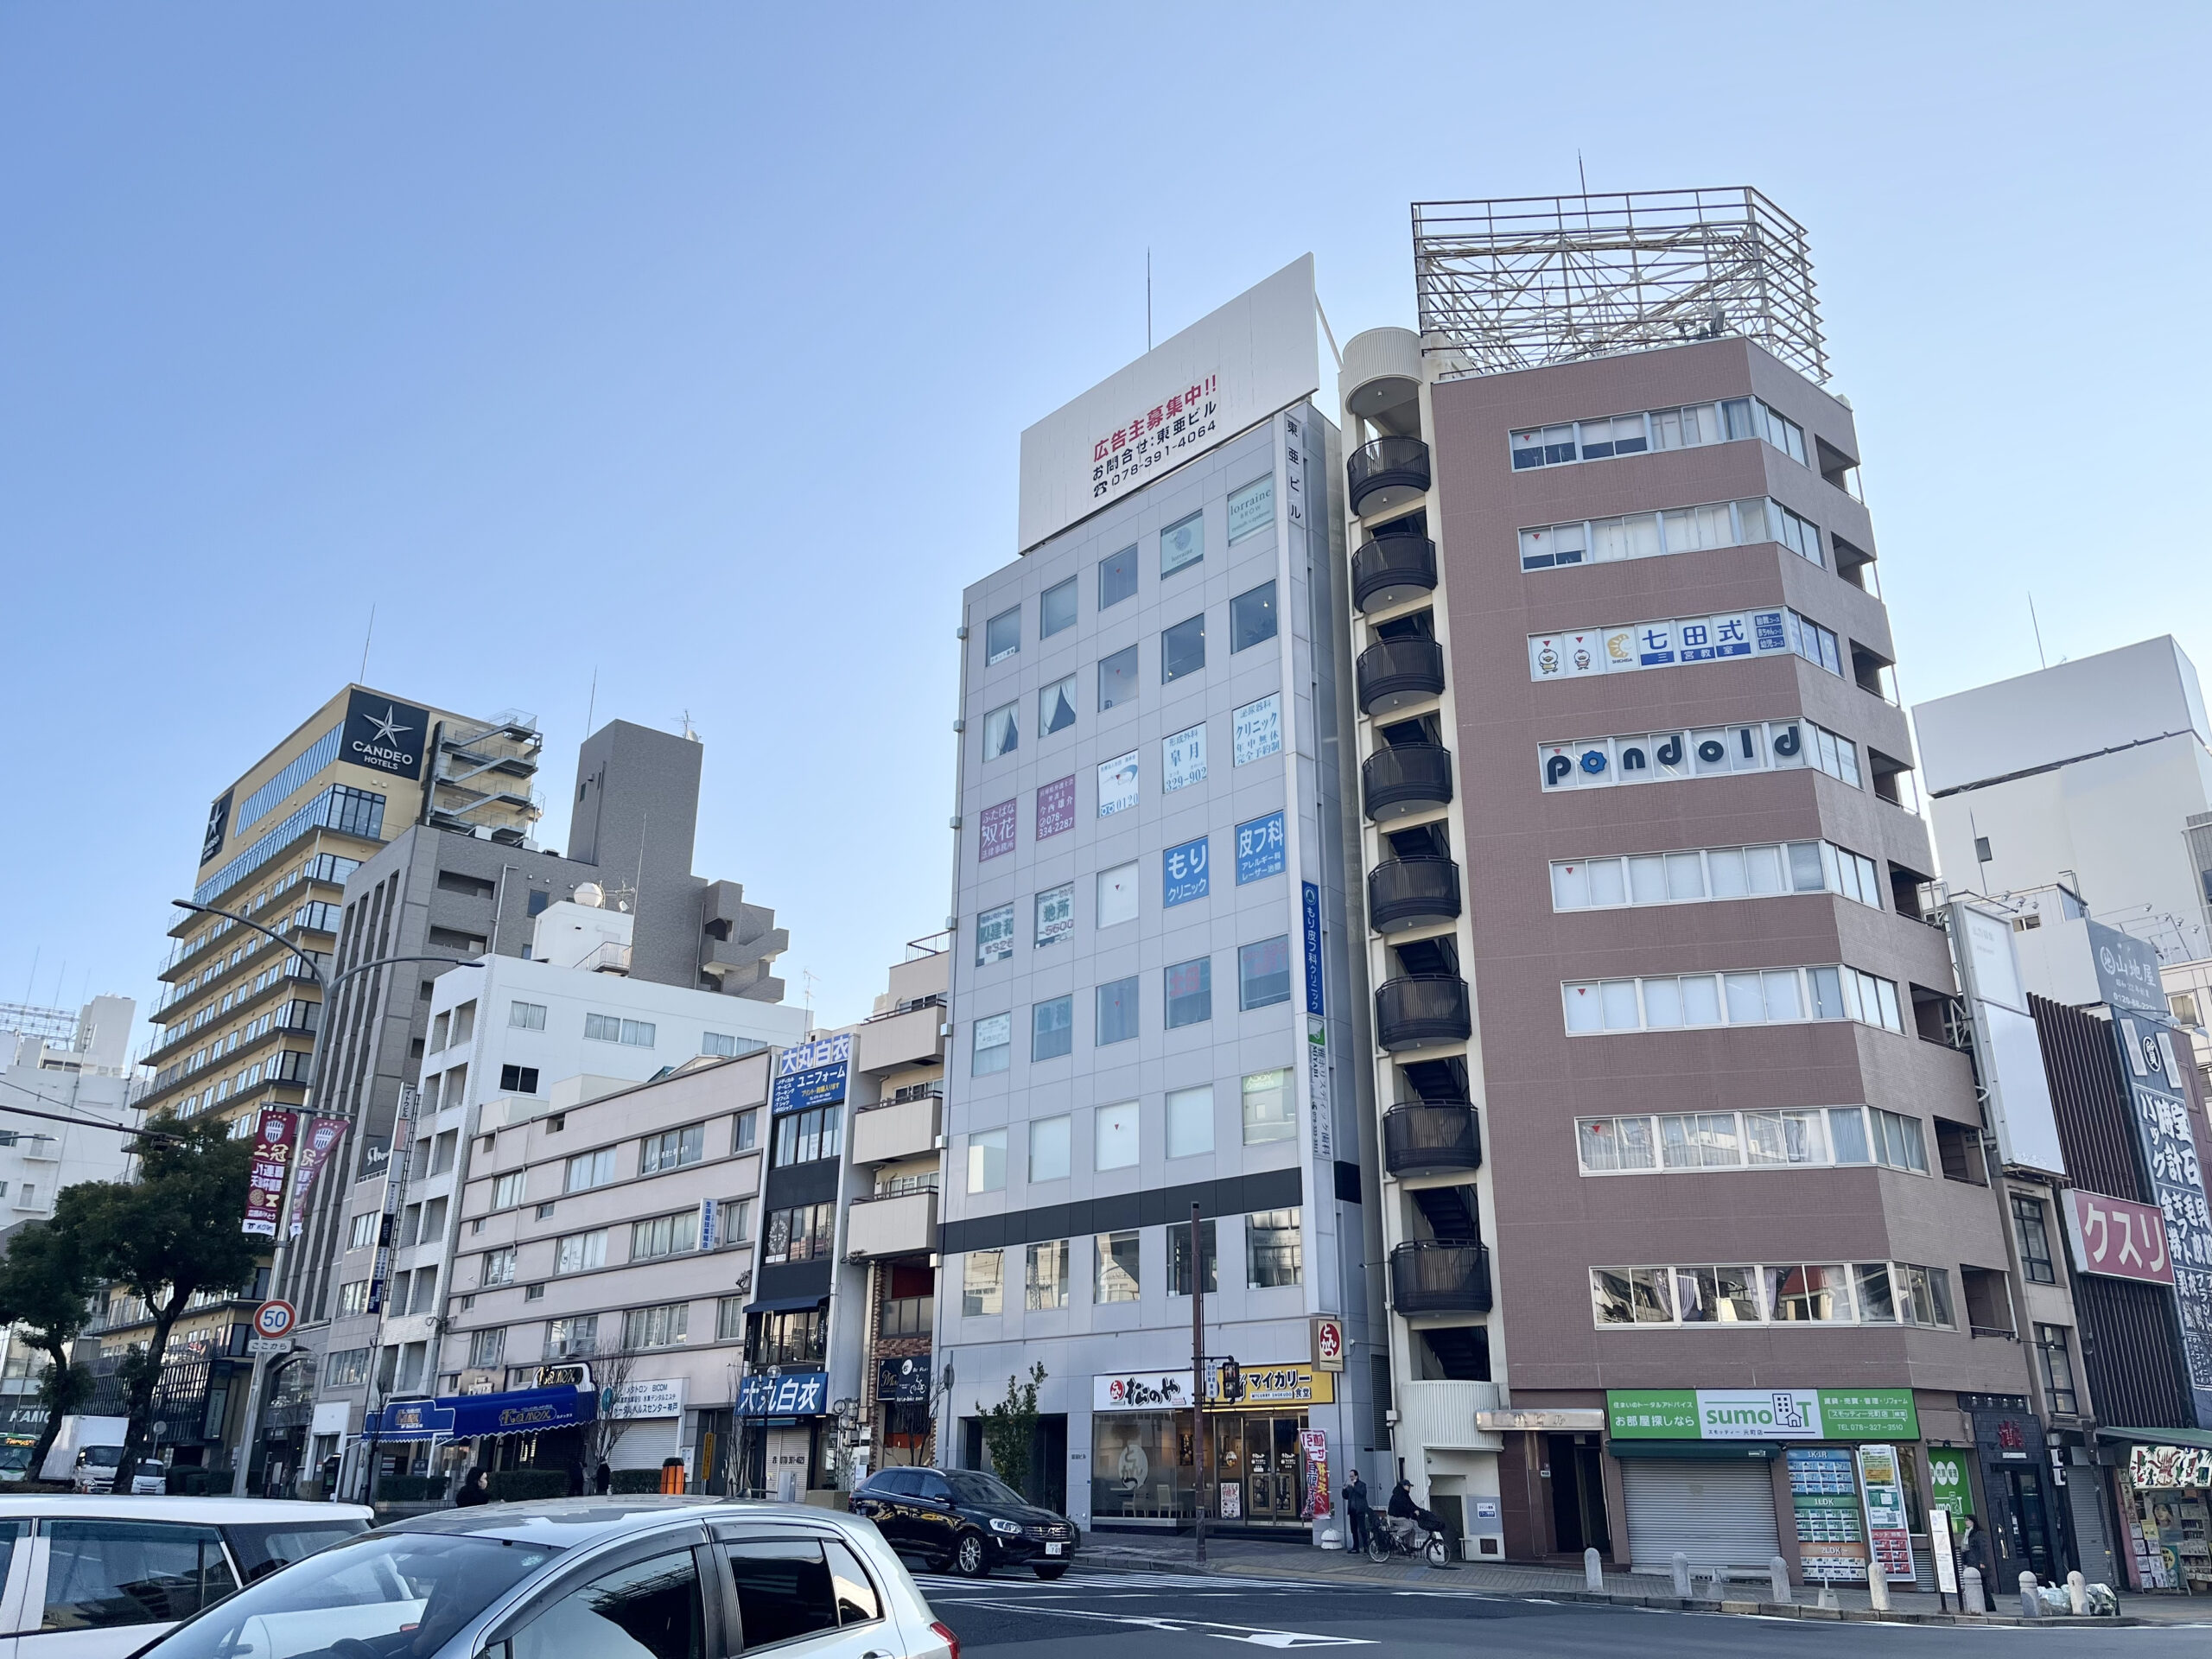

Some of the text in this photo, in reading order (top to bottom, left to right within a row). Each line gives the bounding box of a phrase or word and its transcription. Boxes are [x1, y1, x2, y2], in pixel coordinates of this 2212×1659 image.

[1093, 374, 1217, 462] 広告主募集中!!
[1111, 421, 1217, 486] 078-391-4064
[1287, 420, 1301, 519] 東亜ビル
[1230, 489, 1272, 516] lorraine
[1643, 620, 1744, 650] 七田式
[1658, 646, 1734, 662] 三宮教室
[1169, 729, 1198, 747] 形成外科
[1236, 712, 1277, 741] クリニック
[353, 741, 413, 766] CANDEO
[364, 755, 398, 771] HOTELS
[1547, 726, 1801, 785] pondold
[982, 803, 1015, 823] ふたばな
[1116, 792, 1139, 810] 0120
[1039, 817, 1073, 838] 334-2287
[1239, 817, 1284, 859] 皮フ科
[1168, 845, 1206, 880] もり
[1168, 878, 1207, 902] クリニック
[1306, 906, 1319, 1010] もり皮フ科クリニック
[781, 1036, 849, 1075] 大丸白衣
[797, 1065, 846, 1088] ユニフォーム
[253, 1143, 289, 1163] 二冠
[2084, 1202, 2165, 1273] クスリ
[263, 1310, 288, 1328] 50
[251, 1342, 288, 1351] ここから
[1320, 1324, 1338, 1357] とんかつ
[1125, 1376, 1180, 1406] 松のや
[1249, 1370, 1312, 1390] マイカリー
[1295, 1386, 1312, 1399] 食堂
[738, 1376, 821, 1412] 大丸白衣
[1613, 1401, 1694, 1409] 住まいのトータルアドバイス
[1615, 1415, 1695, 1427] お部屋探しなら
